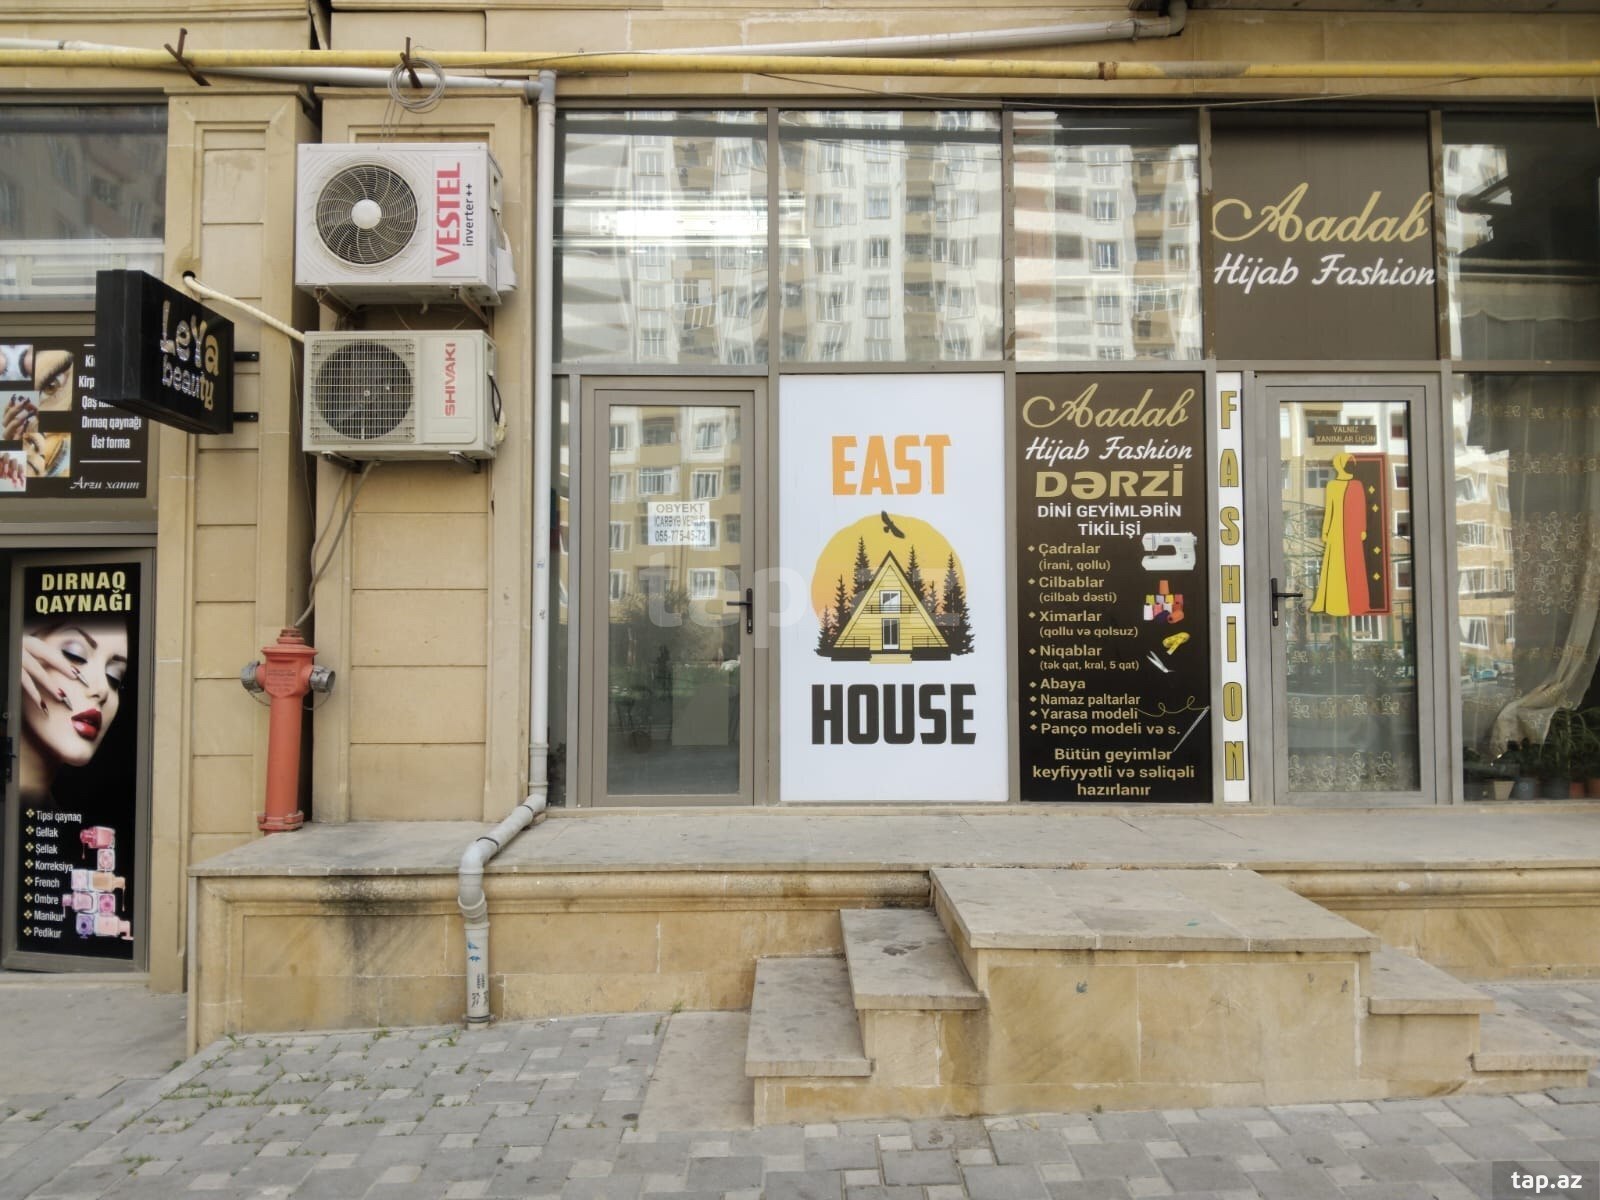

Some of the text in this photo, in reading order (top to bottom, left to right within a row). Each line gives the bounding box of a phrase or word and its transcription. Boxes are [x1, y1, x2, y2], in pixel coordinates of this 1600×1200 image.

[435, 162, 461, 266] VESTEL
[1210, 182, 1433, 242] Aadab
[1214, 252, 1436, 295] Hijab Fashion
[445, 343, 456, 416] SHIVAKI
[1022, 382, 1196, 429] Aadab
[91, 434, 131, 449] Üst forma
[1024, 435, 1193, 468] Hijab Fashion
[831, 434, 952, 496] EAST
[1034, 463, 1184, 500] DƏRZİ
[656, 503, 706, 514] OBYEKT
[1037, 502, 1072, 518] DİNİ
[1038, 542, 1101, 557] Çadralar
[1076, 559, 1111, 572] qollu)
[41, 571, 126, 591] DIRNAQ
[1038, 576, 1105, 588] Cilbablar
[35, 589, 132, 615] QAYNAĞI
[1039, 592, 1117, 604] (cilbab dəsti)
[1039, 610, 1102, 623] Ximarlar
[1039, 626, 1139, 639] (qollu və qolsuz)
[1039, 644, 1102, 659] Niqablar
[1109, 661, 1116, 670] 5
[1118, 661, 1140, 672] qat)
[1040, 677, 1086, 692] Abaya
[1040, 693, 1141, 708] Namaz paltarlar
[811, 684, 977, 745] HOUSE
[1040, 707, 1138, 720] Yarasa modeli
[1040, 722, 1181, 737] Panço modeli və s.
[1054, 748, 1172, 765] Bütün geyimlər
[1116, 768, 1135, 778] və
[36, 810, 53, 821] Tipsi
[34, 860, 73, 874] Korreksiya
[34, 877, 60, 888] French
[34, 893, 59, 905] Ombre
